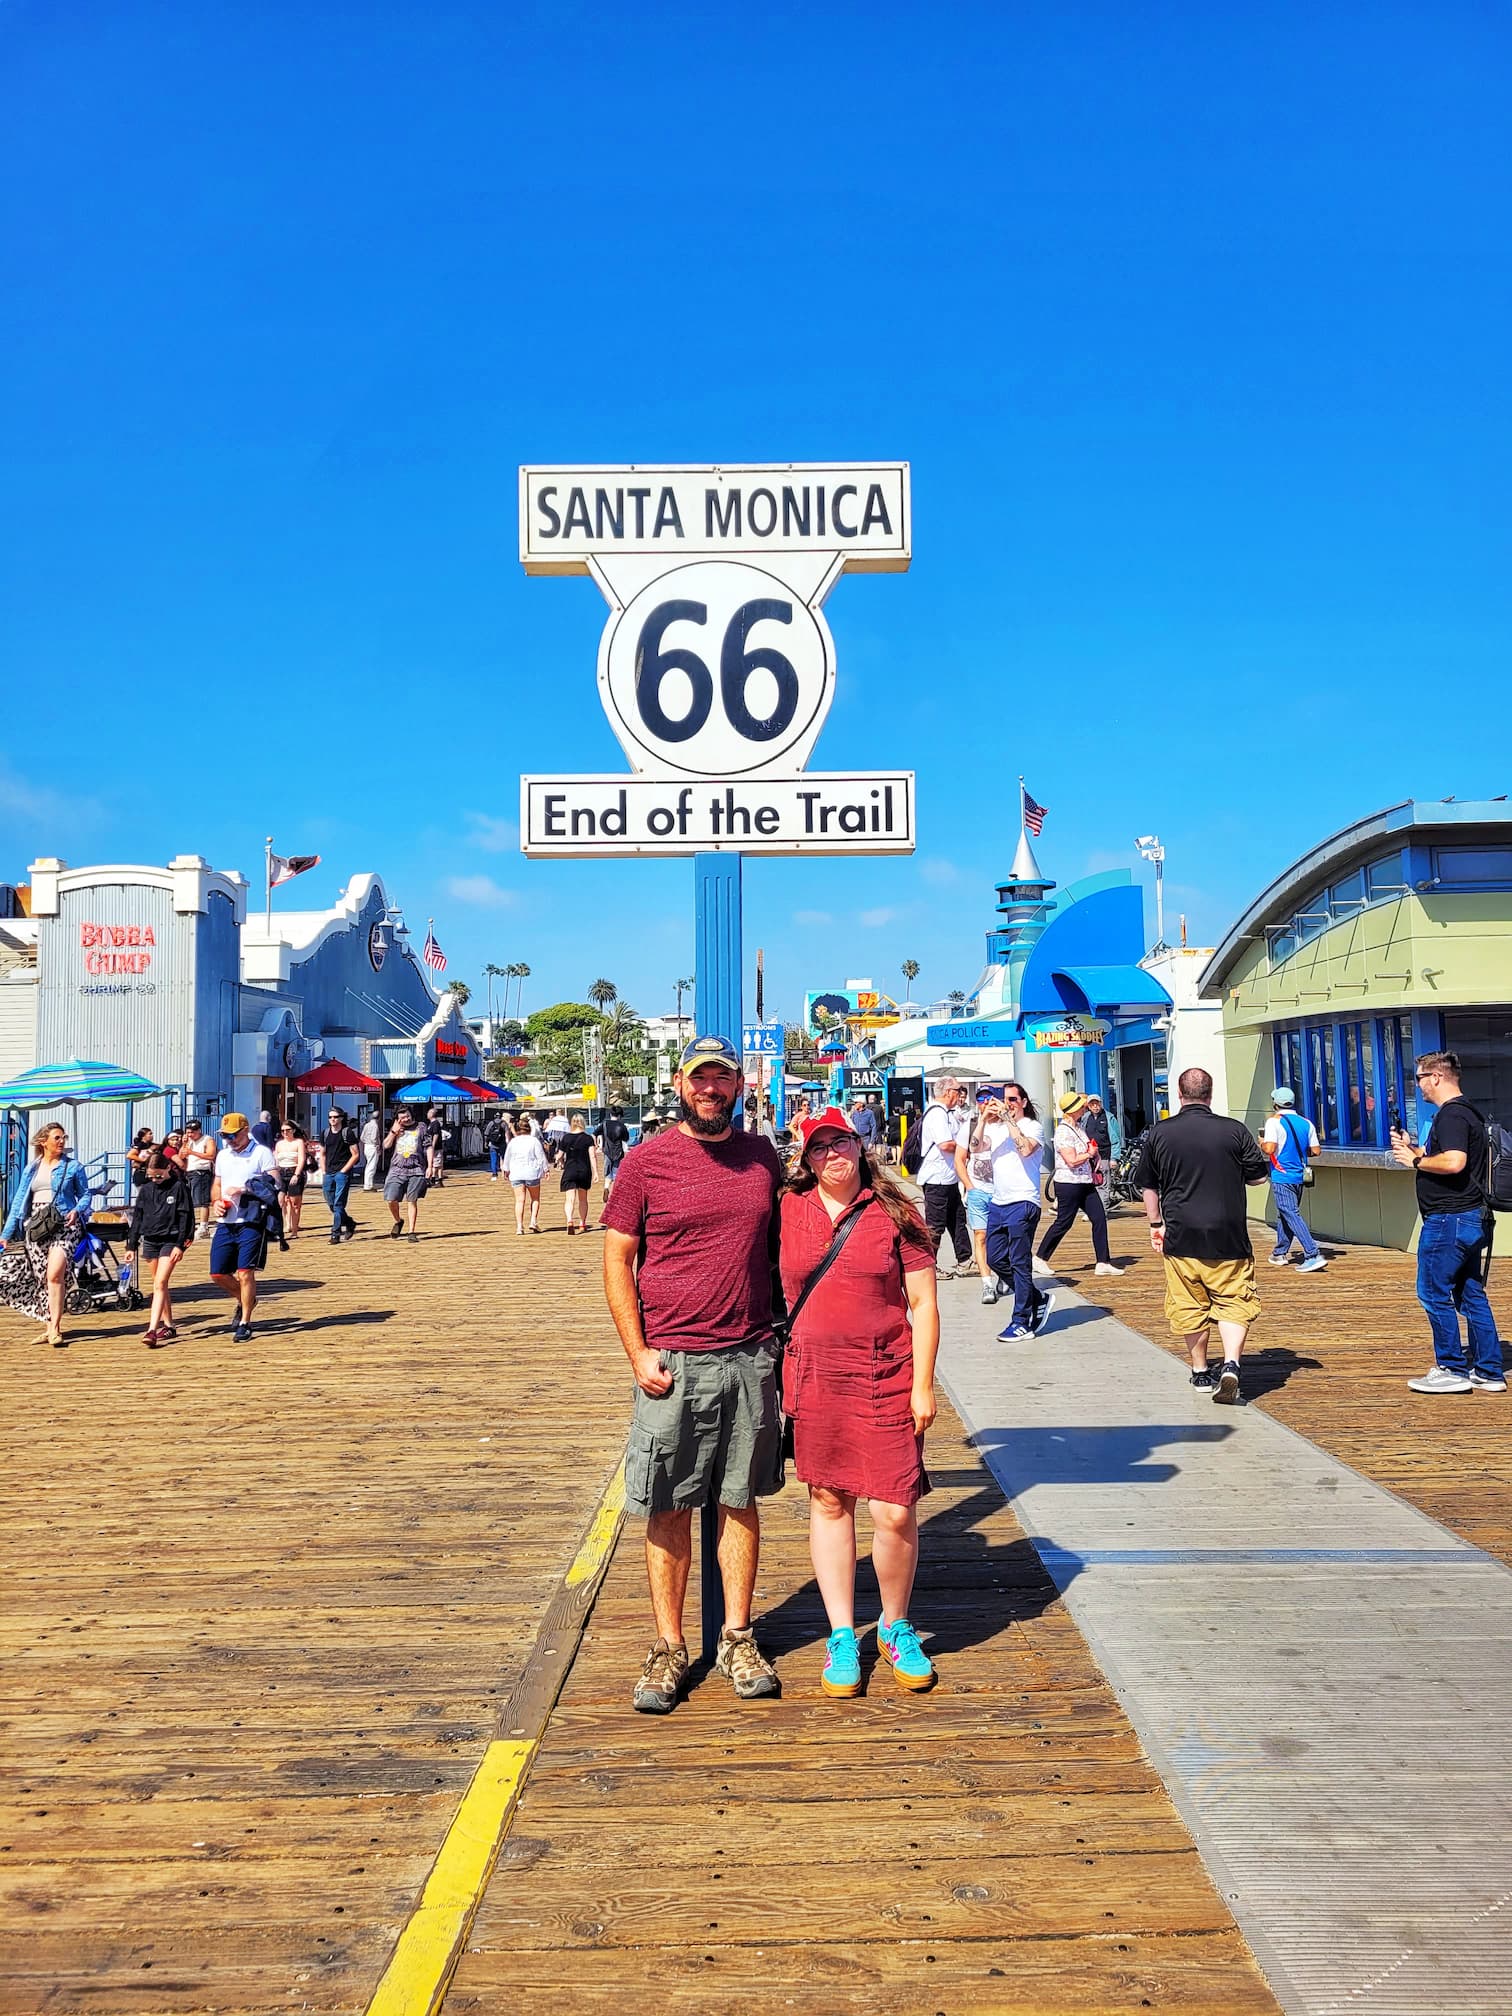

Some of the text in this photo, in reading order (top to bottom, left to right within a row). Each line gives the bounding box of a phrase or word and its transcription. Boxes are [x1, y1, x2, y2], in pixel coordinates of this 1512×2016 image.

[537, 484, 893, 539] SANTA MONICA
[635, 598, 799, 743] 66
[544, 786, 893, 836] End of the Trail
[80, 922, 156, 947] BUBBA
[86, 950, 151, 976] GUMP
[951, 1026, 989, 1037] POLICE
[1036, 1031, 1069, 1049] BLAZING
[1071, 1029, 1104, 1046] SADDLES
[851, 1071, 882, 1086] BAR
